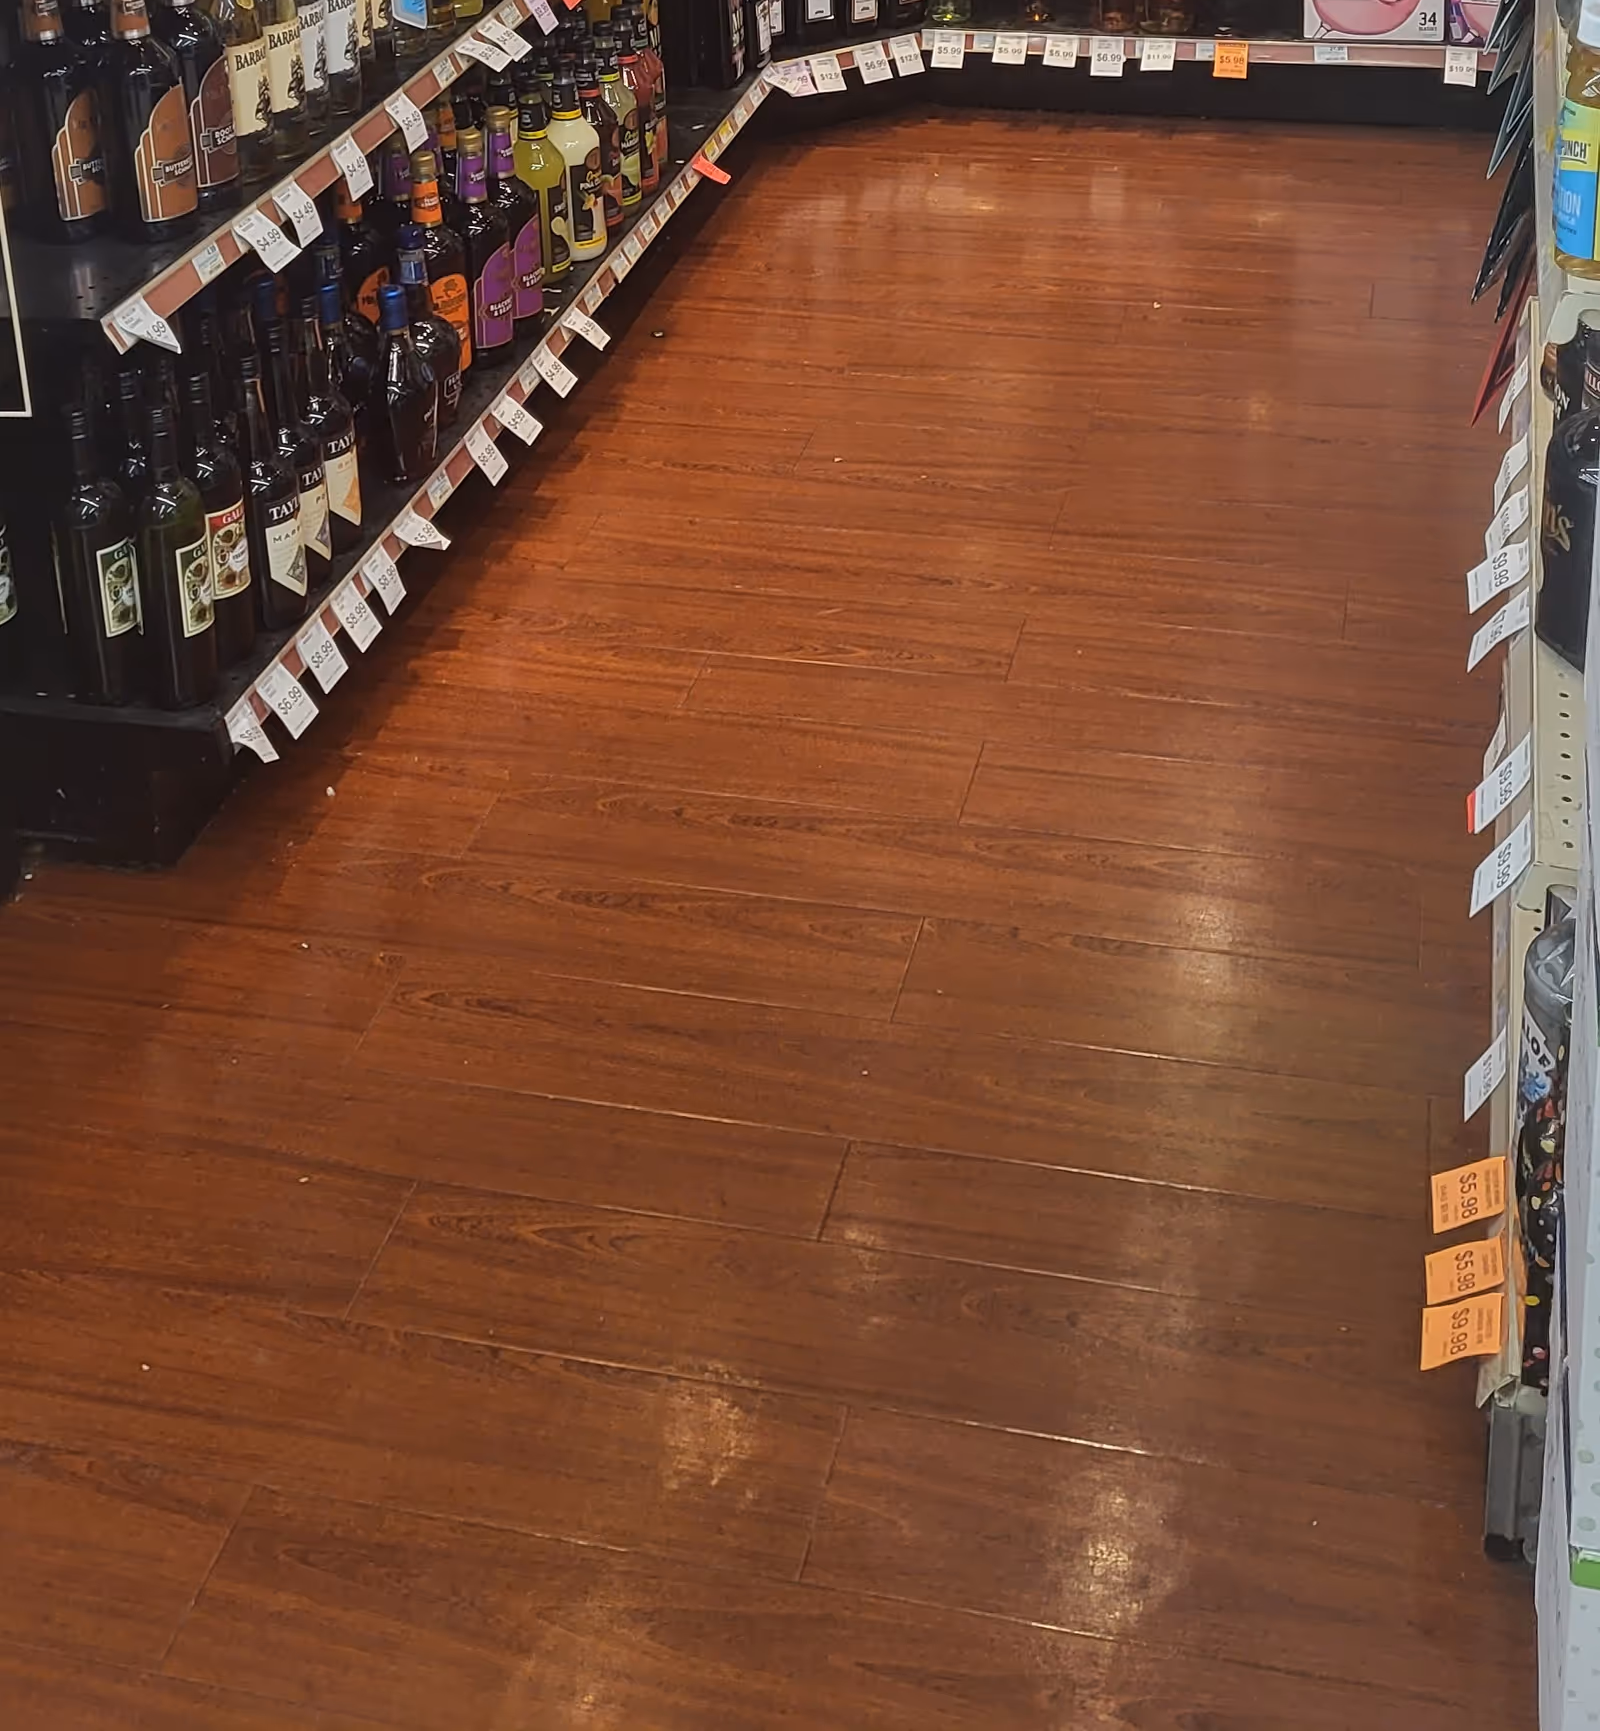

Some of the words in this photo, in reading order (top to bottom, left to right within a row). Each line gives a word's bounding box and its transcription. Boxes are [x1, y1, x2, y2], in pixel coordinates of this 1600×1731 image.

[1419, 12, 1437, 26] 34
[1096, 54, 1122, 62] $6.99
[1219, 56, 1244, 64] $5.98
[346, 156, 366, 177] $4.49
[292, 201, 313, 224] $4.49
[256, 228, 281, 252] $4.99
[414, 523, 434, 543] $5.99
[378, 564, 396, 589] $8.99
[1492, 552, 1509, 588] $9.99
[346, 602, 367, 628] $8.99
[311, 640, 333, 668] $8.99
[278, 686, 302, 715] $6.99
[1499, 760, 1512, 805] $9.99
[1496, 842, 1512, 888] $9.99
[1459, 1171, 1478, 1220] $5.98
[1455, 1249, 1476, 1293] $5.98
[1450, 1307, 1468, 1356] $9.98
